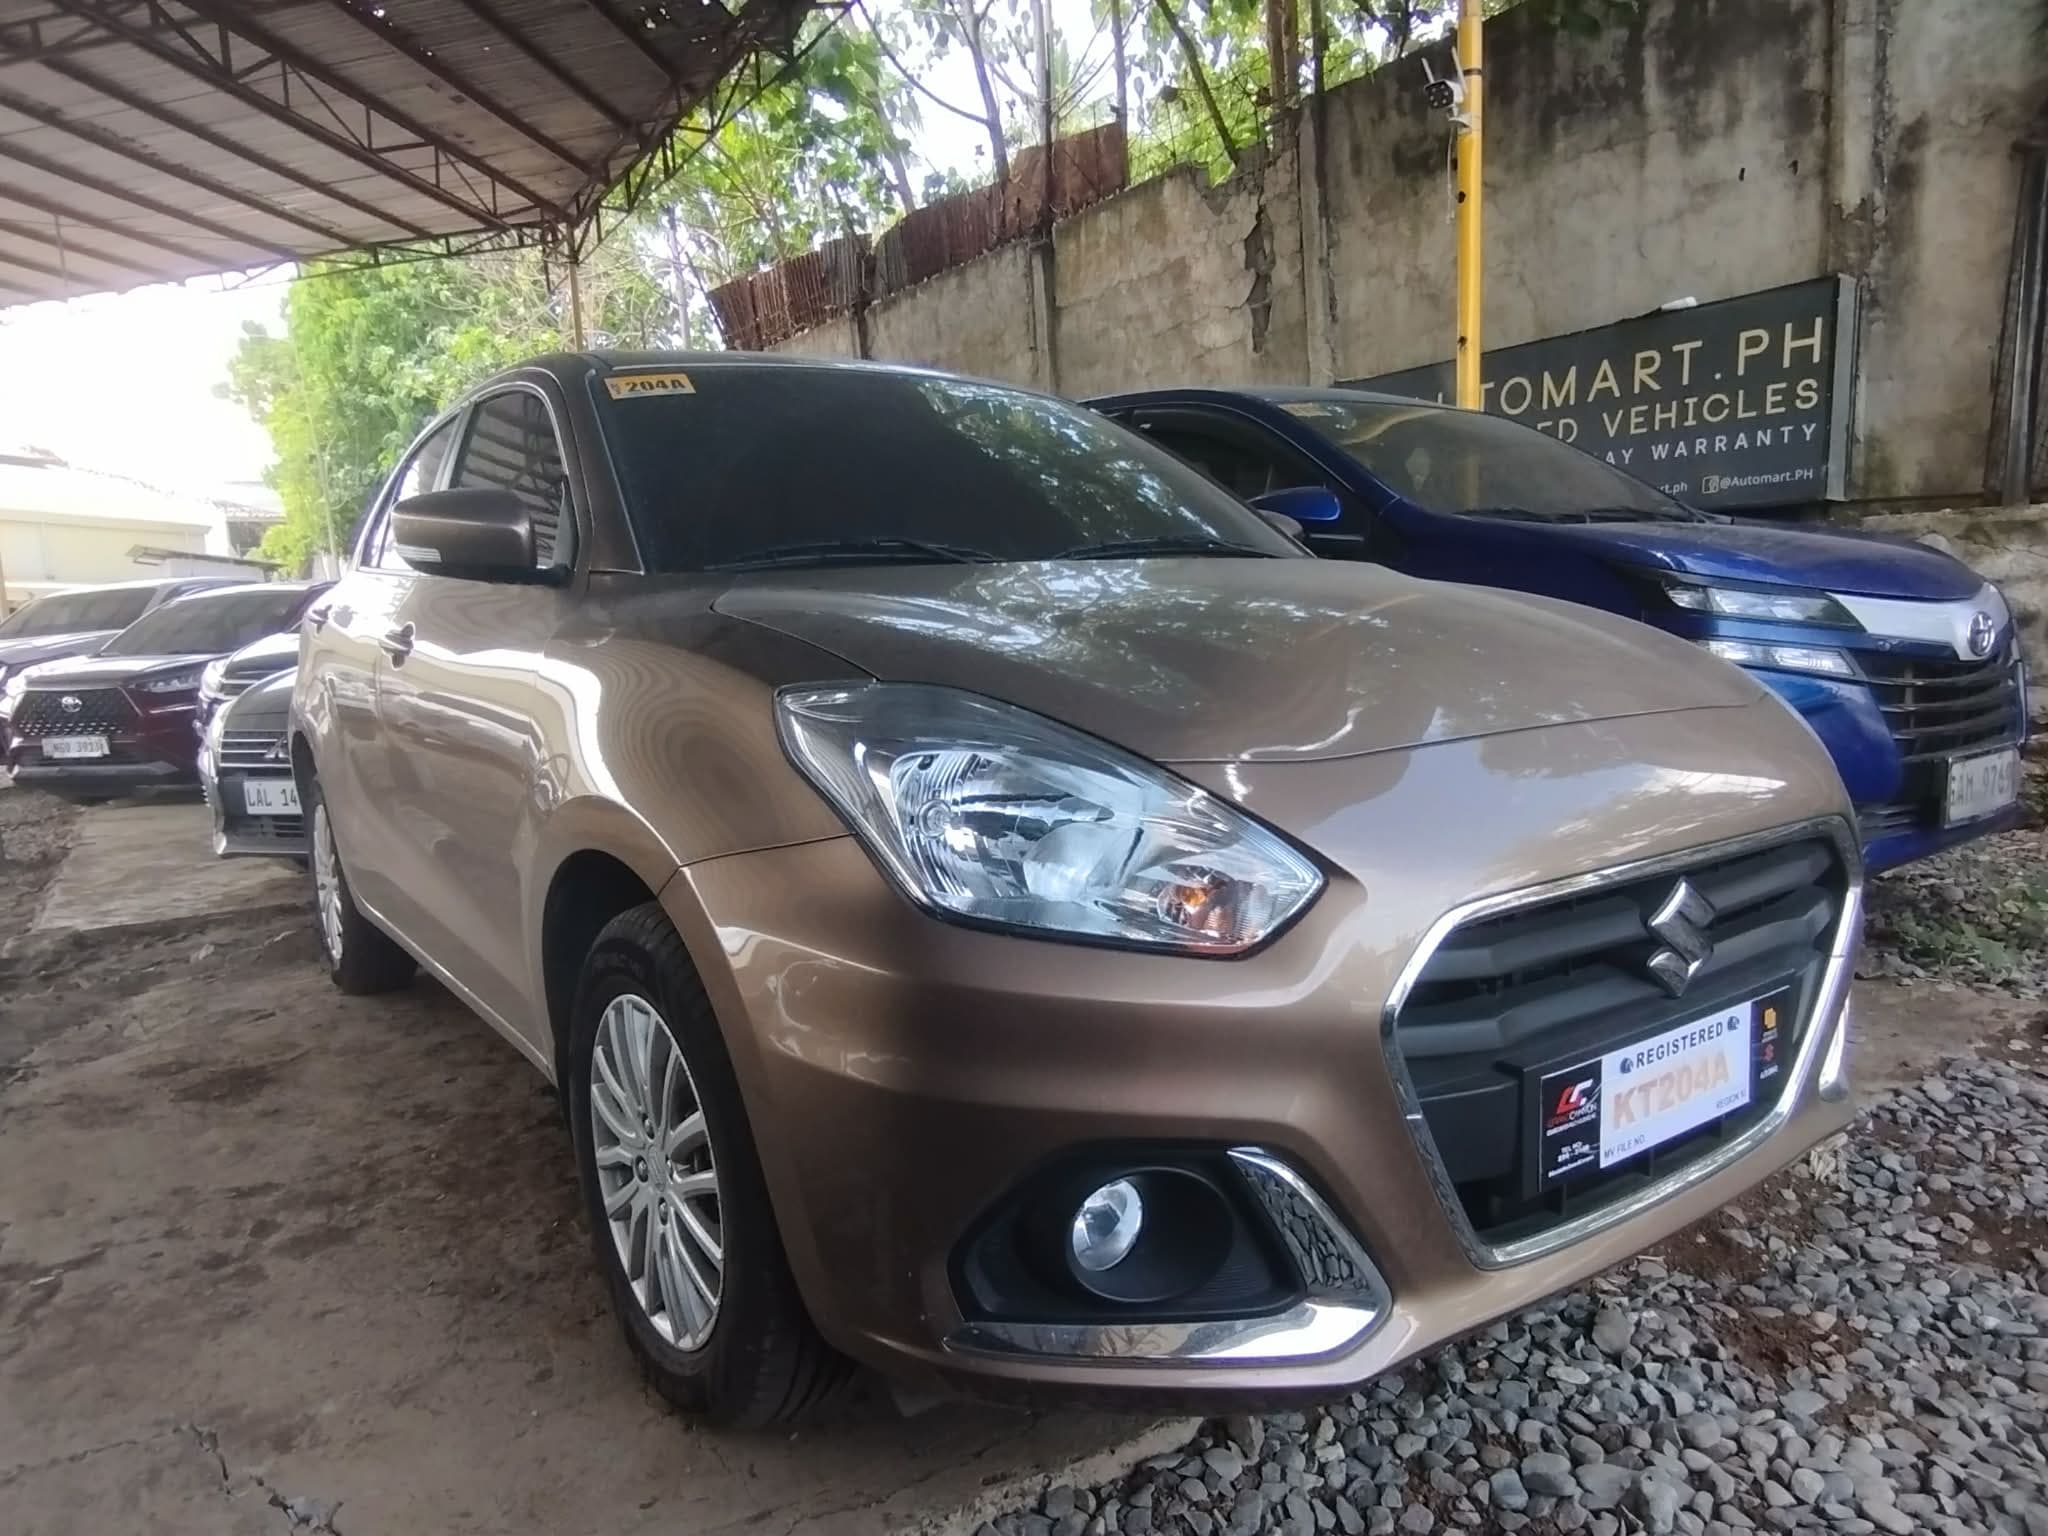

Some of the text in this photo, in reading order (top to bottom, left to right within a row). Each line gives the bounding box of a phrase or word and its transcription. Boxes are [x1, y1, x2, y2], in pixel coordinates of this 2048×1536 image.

[1416, 316, 1823, 415] TOMART.PH
[1602, 378, 1818, 438] VEHICLES
[1602, 423, 1817, 465] AY WARRANTY
[1719, 468, 1814, 490] @Automart.PH
[246, 787, 298, 808] LAL 14
[1635, 1020, 1724, 1070] REGISTERED
[1613, 1048, 1730, 1130] KT204A
